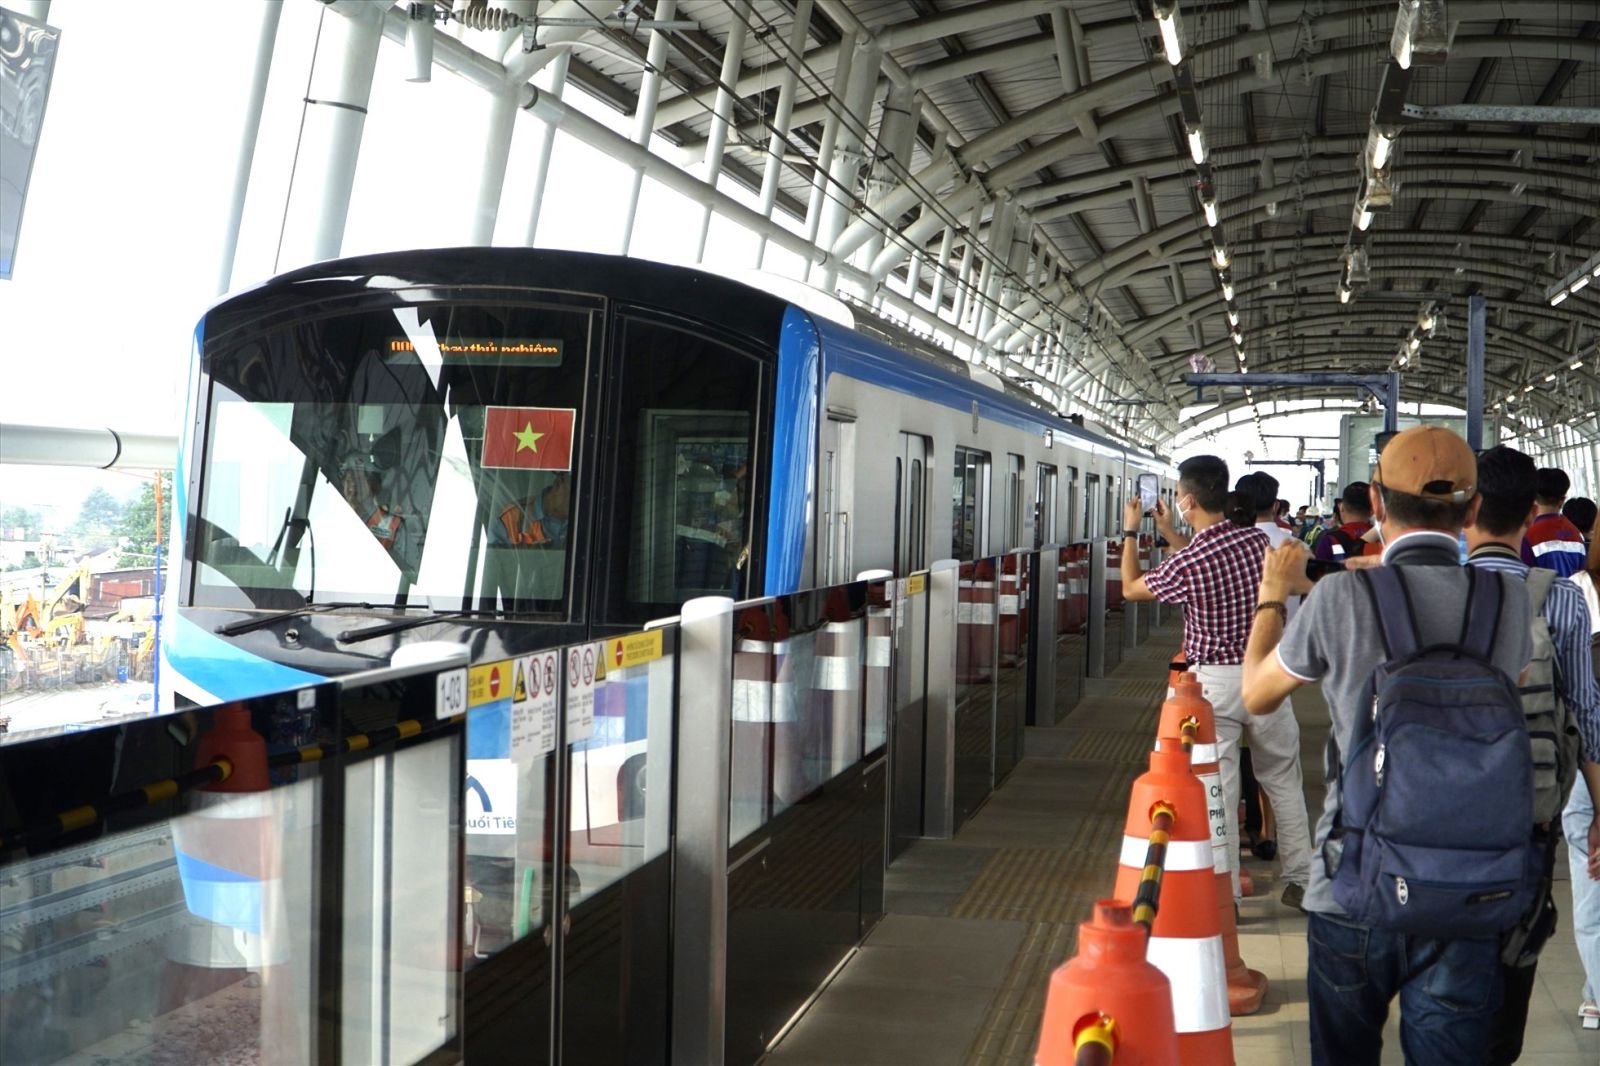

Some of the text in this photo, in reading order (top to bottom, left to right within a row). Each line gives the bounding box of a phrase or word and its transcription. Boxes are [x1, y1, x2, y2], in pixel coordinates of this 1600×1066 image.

[441, 675, 461, 712] 1-03
[1210, 784, 1223, 798] CH
[465, 815, 517, 829] uối Tiê
